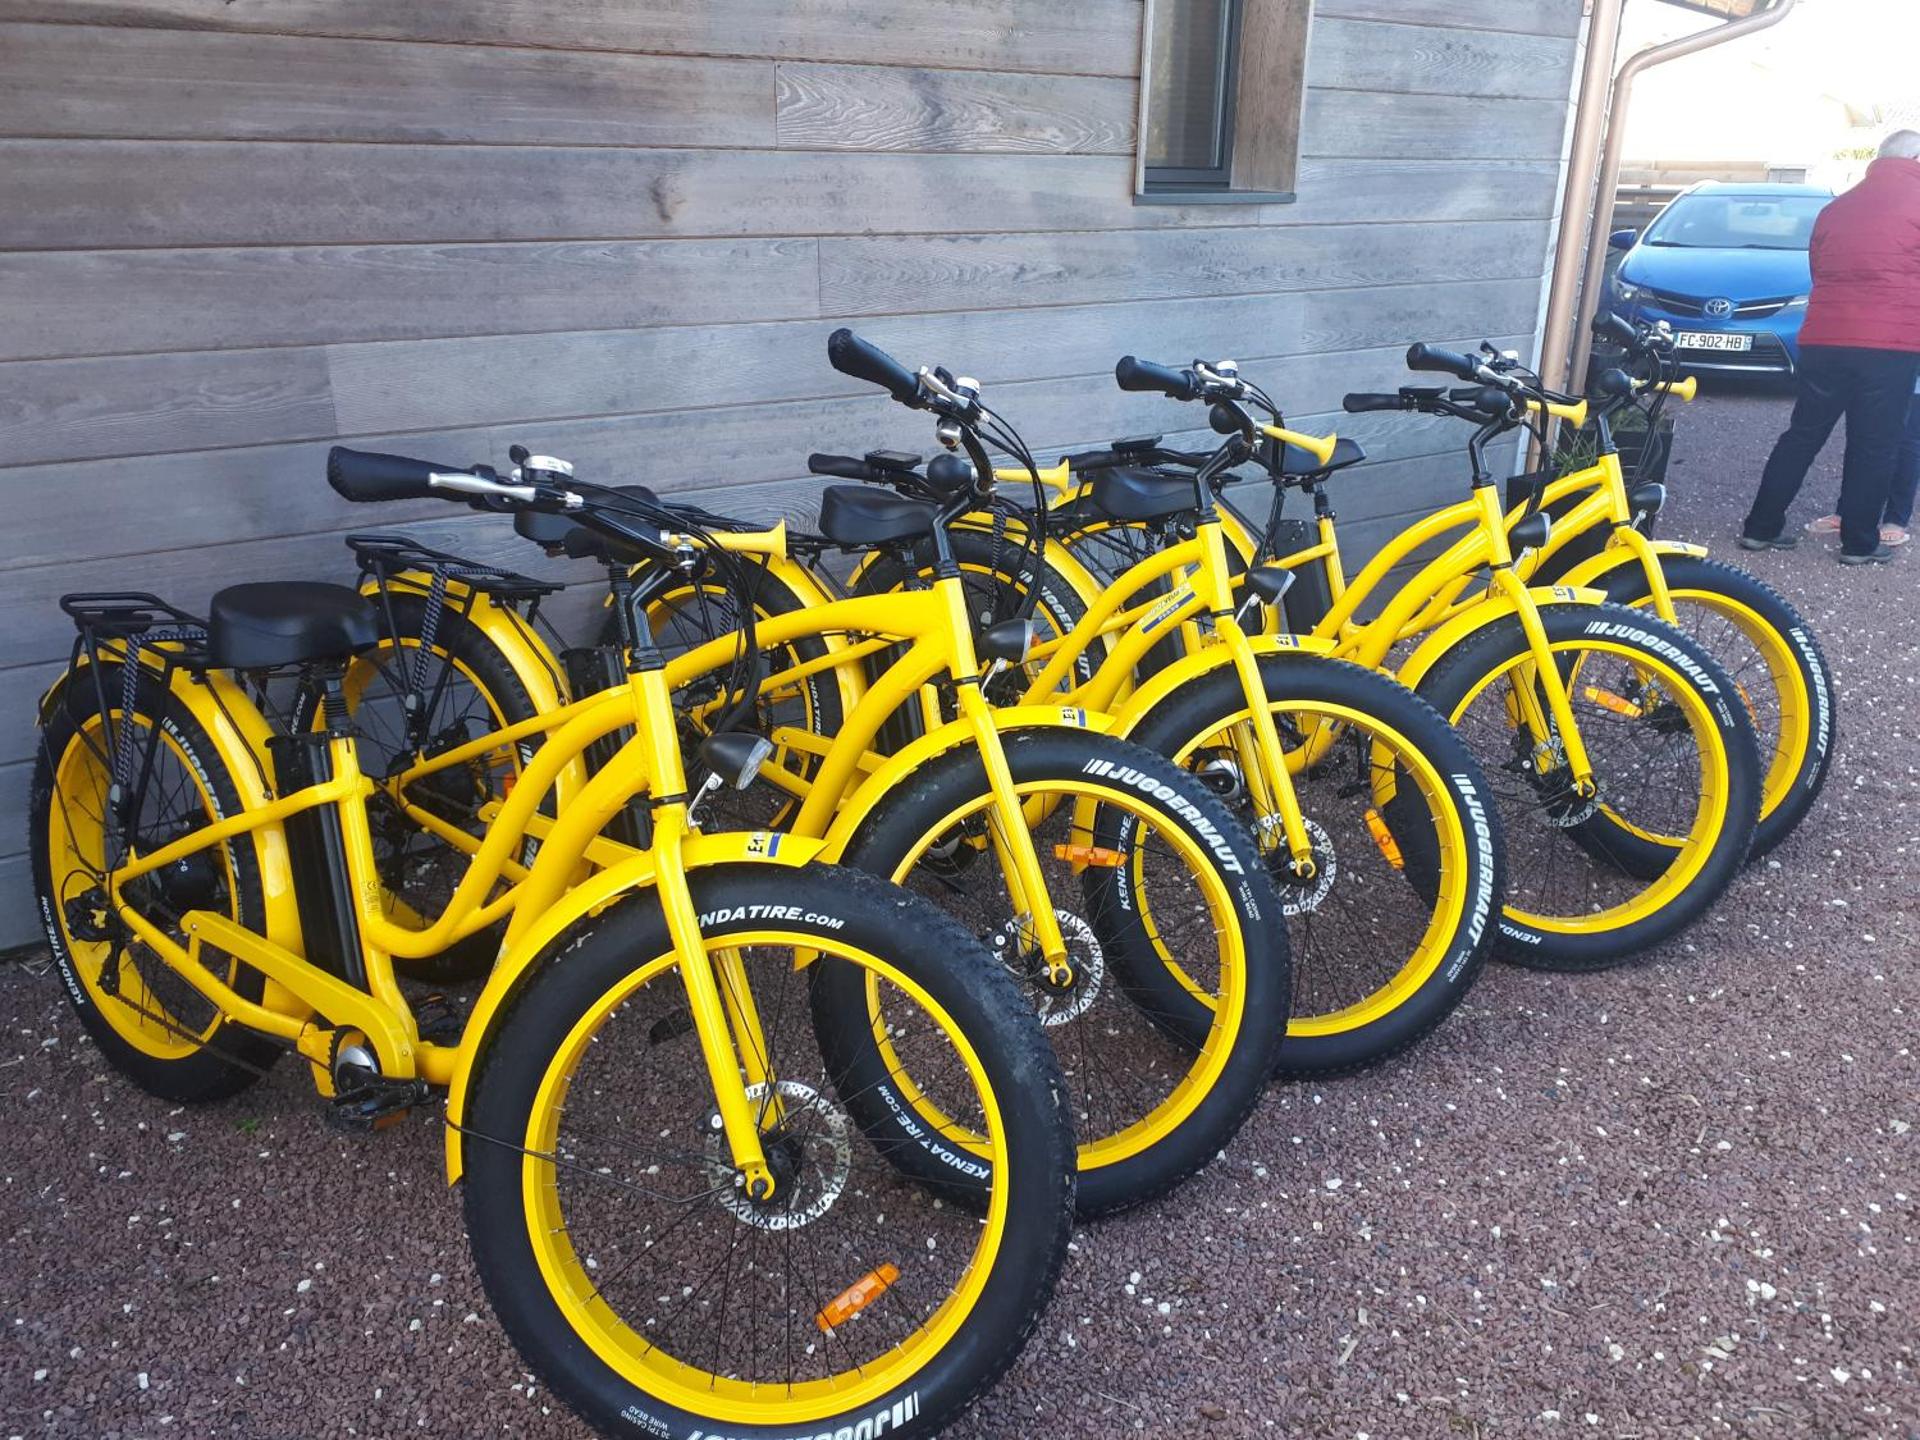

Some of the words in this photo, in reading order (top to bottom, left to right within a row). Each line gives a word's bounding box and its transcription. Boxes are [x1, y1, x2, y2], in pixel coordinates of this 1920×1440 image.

[1679, 333, 1742, 349] FC-902-HB
[1604, 624, 1720, 694] JUGGERNAUT
[1799, 641, 1829, 758] JUGGERNAUT
[1107, 765, 1245, 876] JUGGERNAUT
[1463, 793, 1494, 948] JUGGERNAUT
[41, 895, 85, 1004] KENDATIRE.COM
[877, 1085, 990, 1180] KENDATIRE.COM
